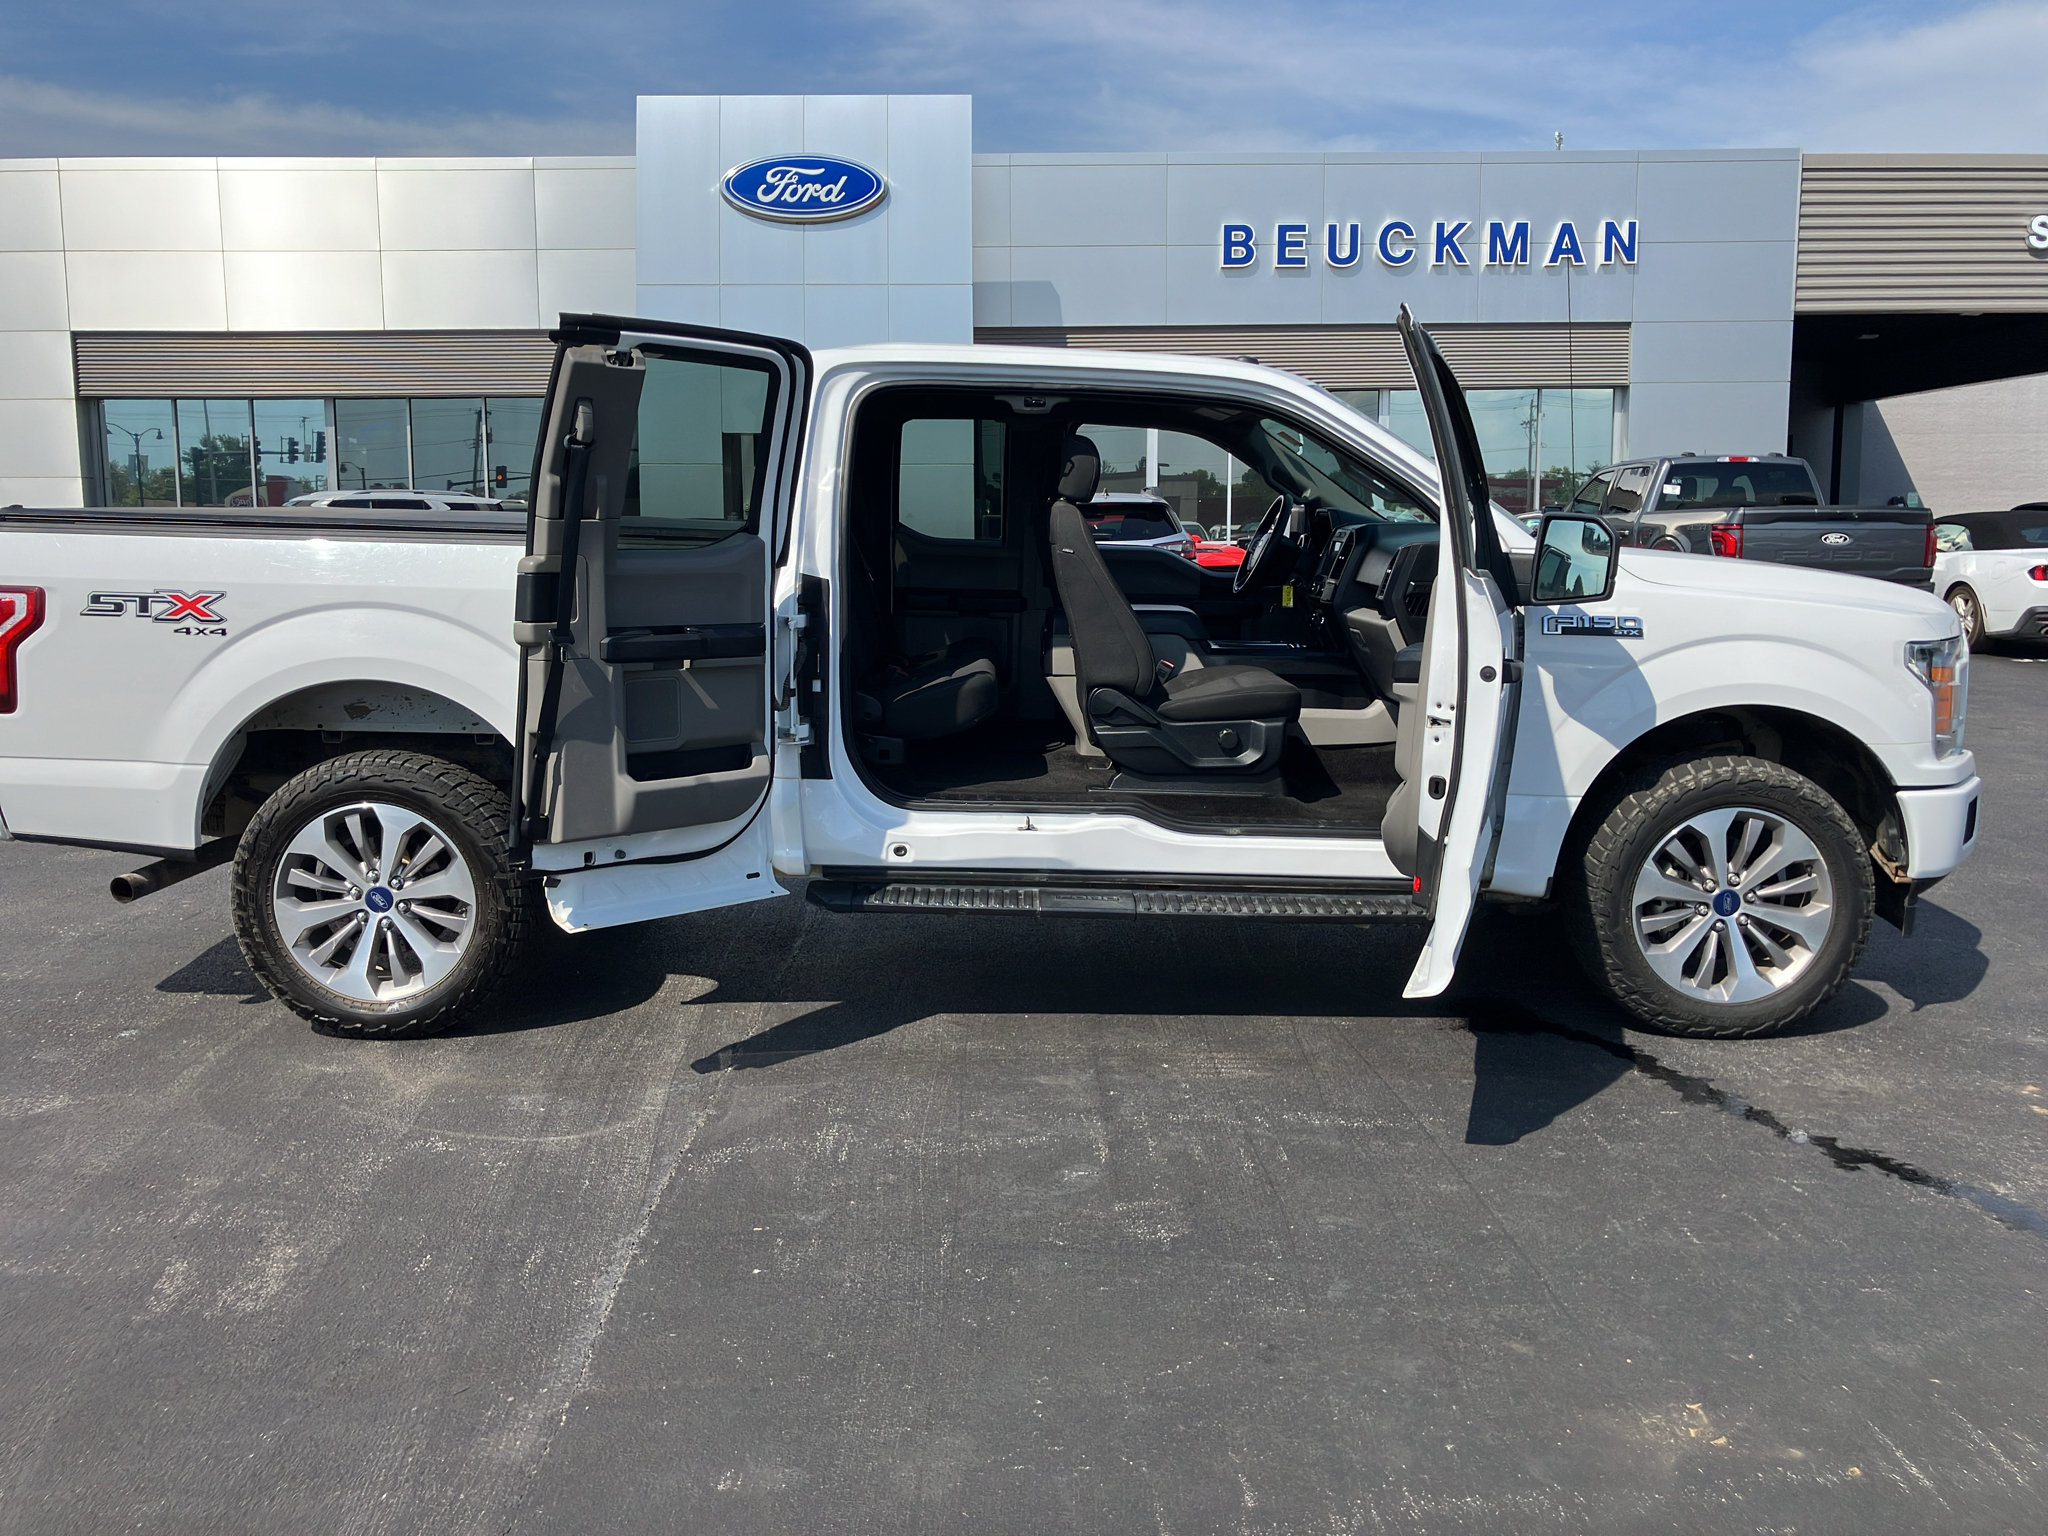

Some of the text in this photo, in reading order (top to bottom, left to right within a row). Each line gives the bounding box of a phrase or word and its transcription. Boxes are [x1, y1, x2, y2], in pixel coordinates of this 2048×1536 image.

[757, 166, 848, 203] Ford
[1220, 219, 1640, 268] BEUCKMAN
[80, 589, 227, 625] STX
